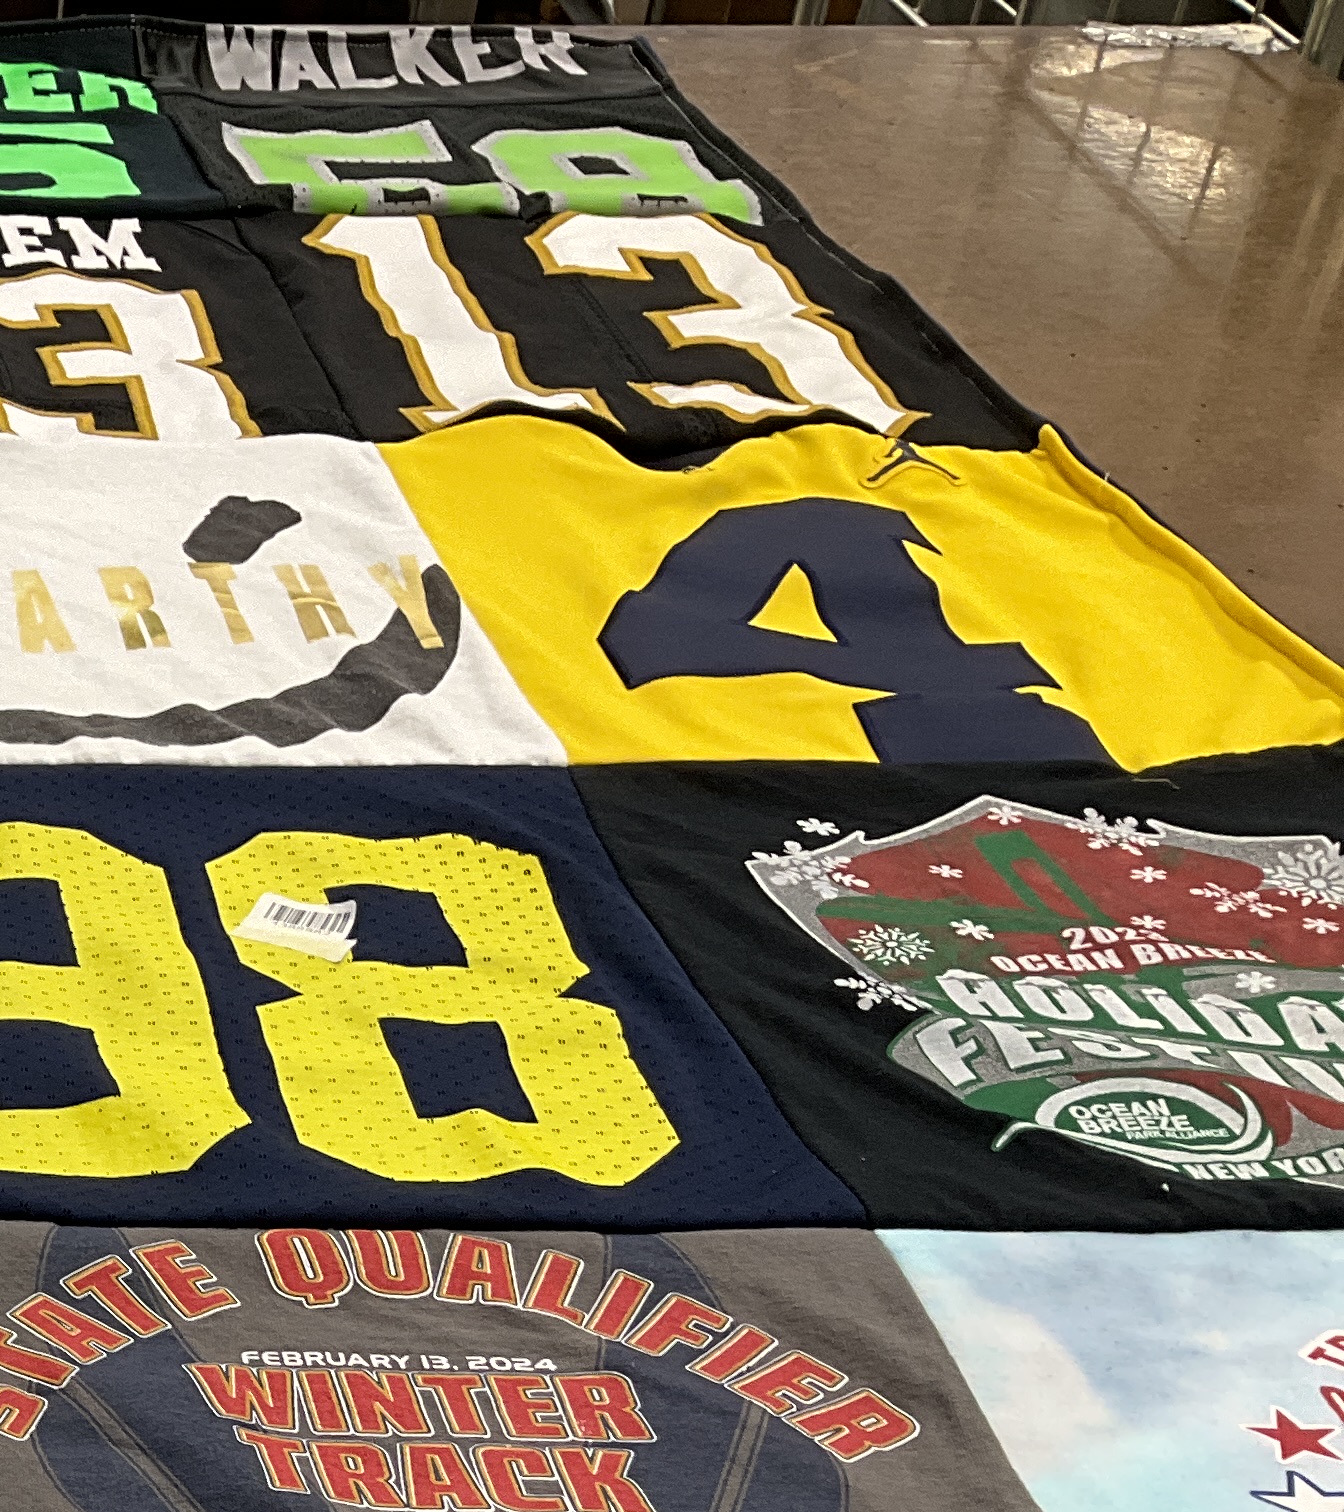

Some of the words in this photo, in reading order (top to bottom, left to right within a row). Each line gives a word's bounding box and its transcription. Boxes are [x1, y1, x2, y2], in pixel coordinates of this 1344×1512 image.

[301, 207, 933, 434] 13
[596, 496, 1136, 768] 4
[990, 948, 1125, 972] OCEAN
[1129, 943, 1277, 965] BREEZE
[935, 969, 1344, 1056] HOLIDA
[1068, 1098, 1171, 1121] OCEAN
[1077, 1114, 1195, 1135] BREEZE
[1182, 1162, 1269, 1181] NEW
[239, 1349, 410, 1371] FEBRUARY
[467, 1356, 558, 1373] 2024
[254, 1228, 921, 1463] QUALIFIER
[182, 1361, 658, 1443] WINTER
